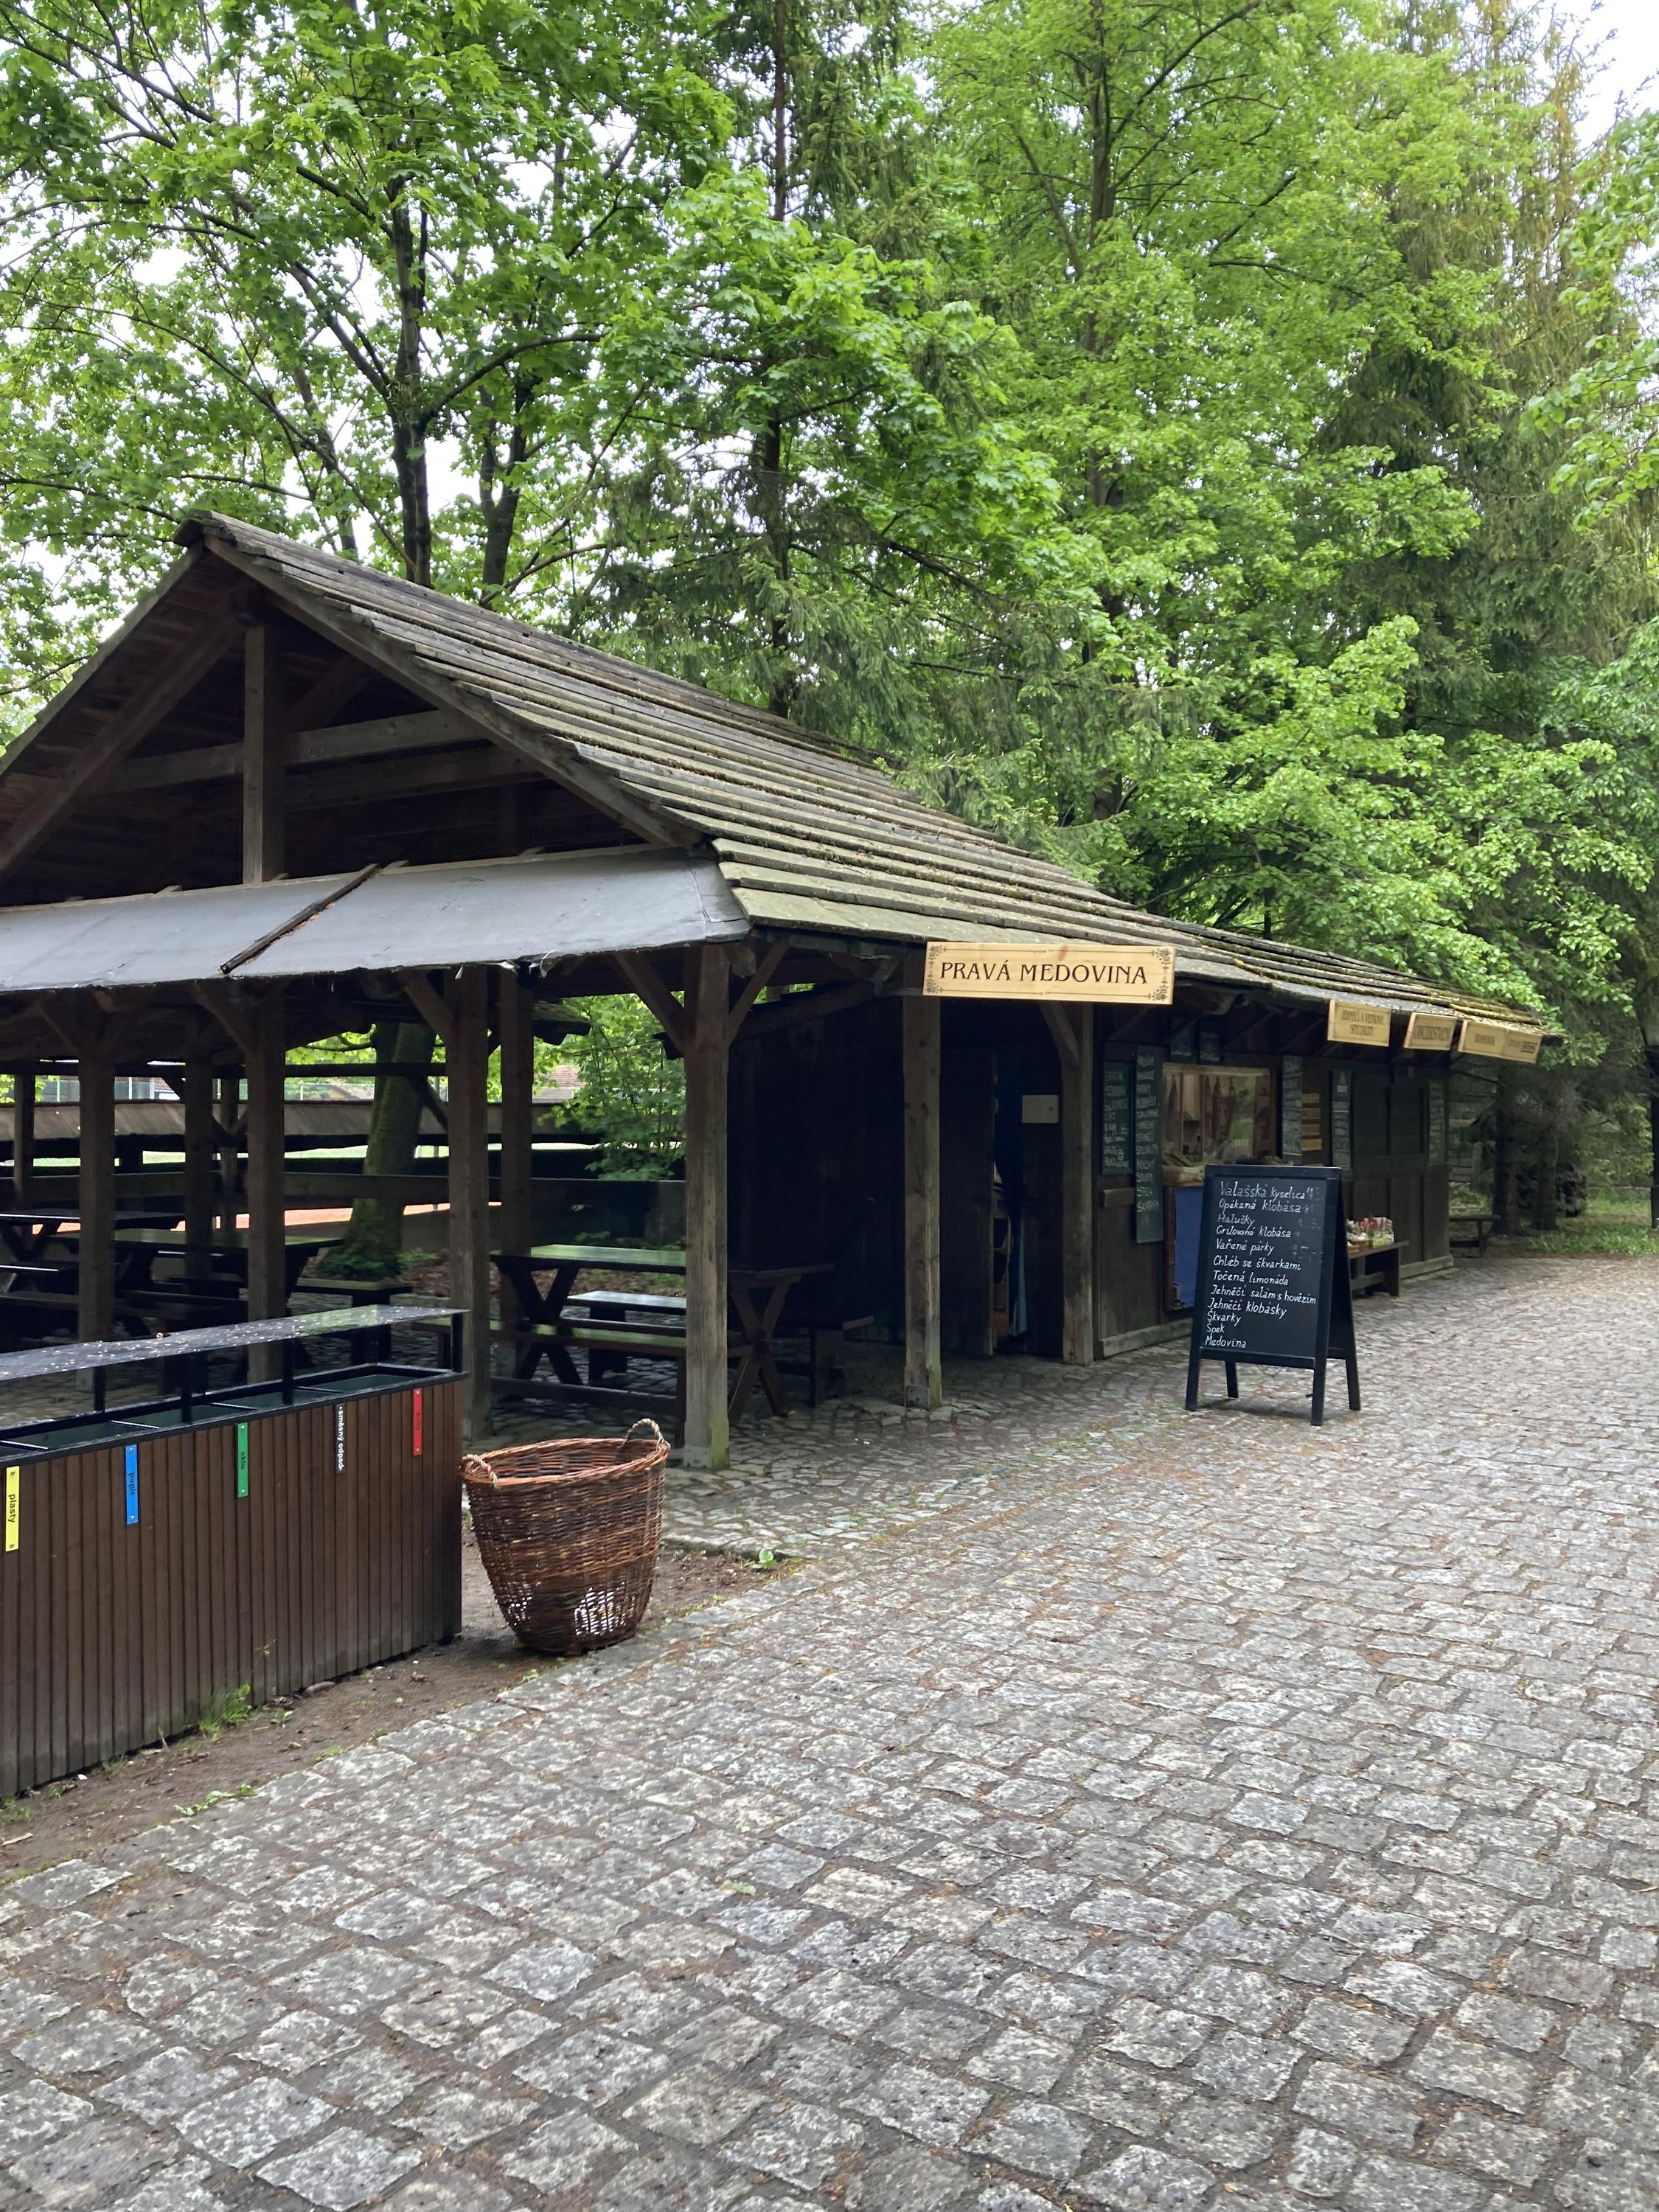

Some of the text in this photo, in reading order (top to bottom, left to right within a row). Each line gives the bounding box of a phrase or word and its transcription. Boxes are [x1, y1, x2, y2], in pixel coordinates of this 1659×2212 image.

[940, 959, 1147, 984] PRAVÁ MEDOVINA
[1220, 1180, 1267, 1197] Valašská
[1219, 1198, 1301, 1214] Opékaná klobása
[1217, 1213, 1255, 1230] Halušky
[1259, 1225, 1291, 1237] klobása
[1216, 1238, 1274, 1256] Vařené párky
[1213, 1255, 1301, 1270] Chléb se škvarkami
[1213, 1270, 1288, 1285] Točená limonáda
[1211, 1284, 1247, 1297] Jehněčí
[1250, 1287, 1276, 1299] salám
[1284, 1290, 1316, 1304] hovězím
[1207, 1307, 1242, 1326] Škvarky
[1208, 1297, 1287, 1319] Jehněčí klobásky
[1206, 1320, 1225, 1336] Špek
[1205, 1335, 1247, 1349] Medovina
[8, 1494, 17, 1523] plasty
